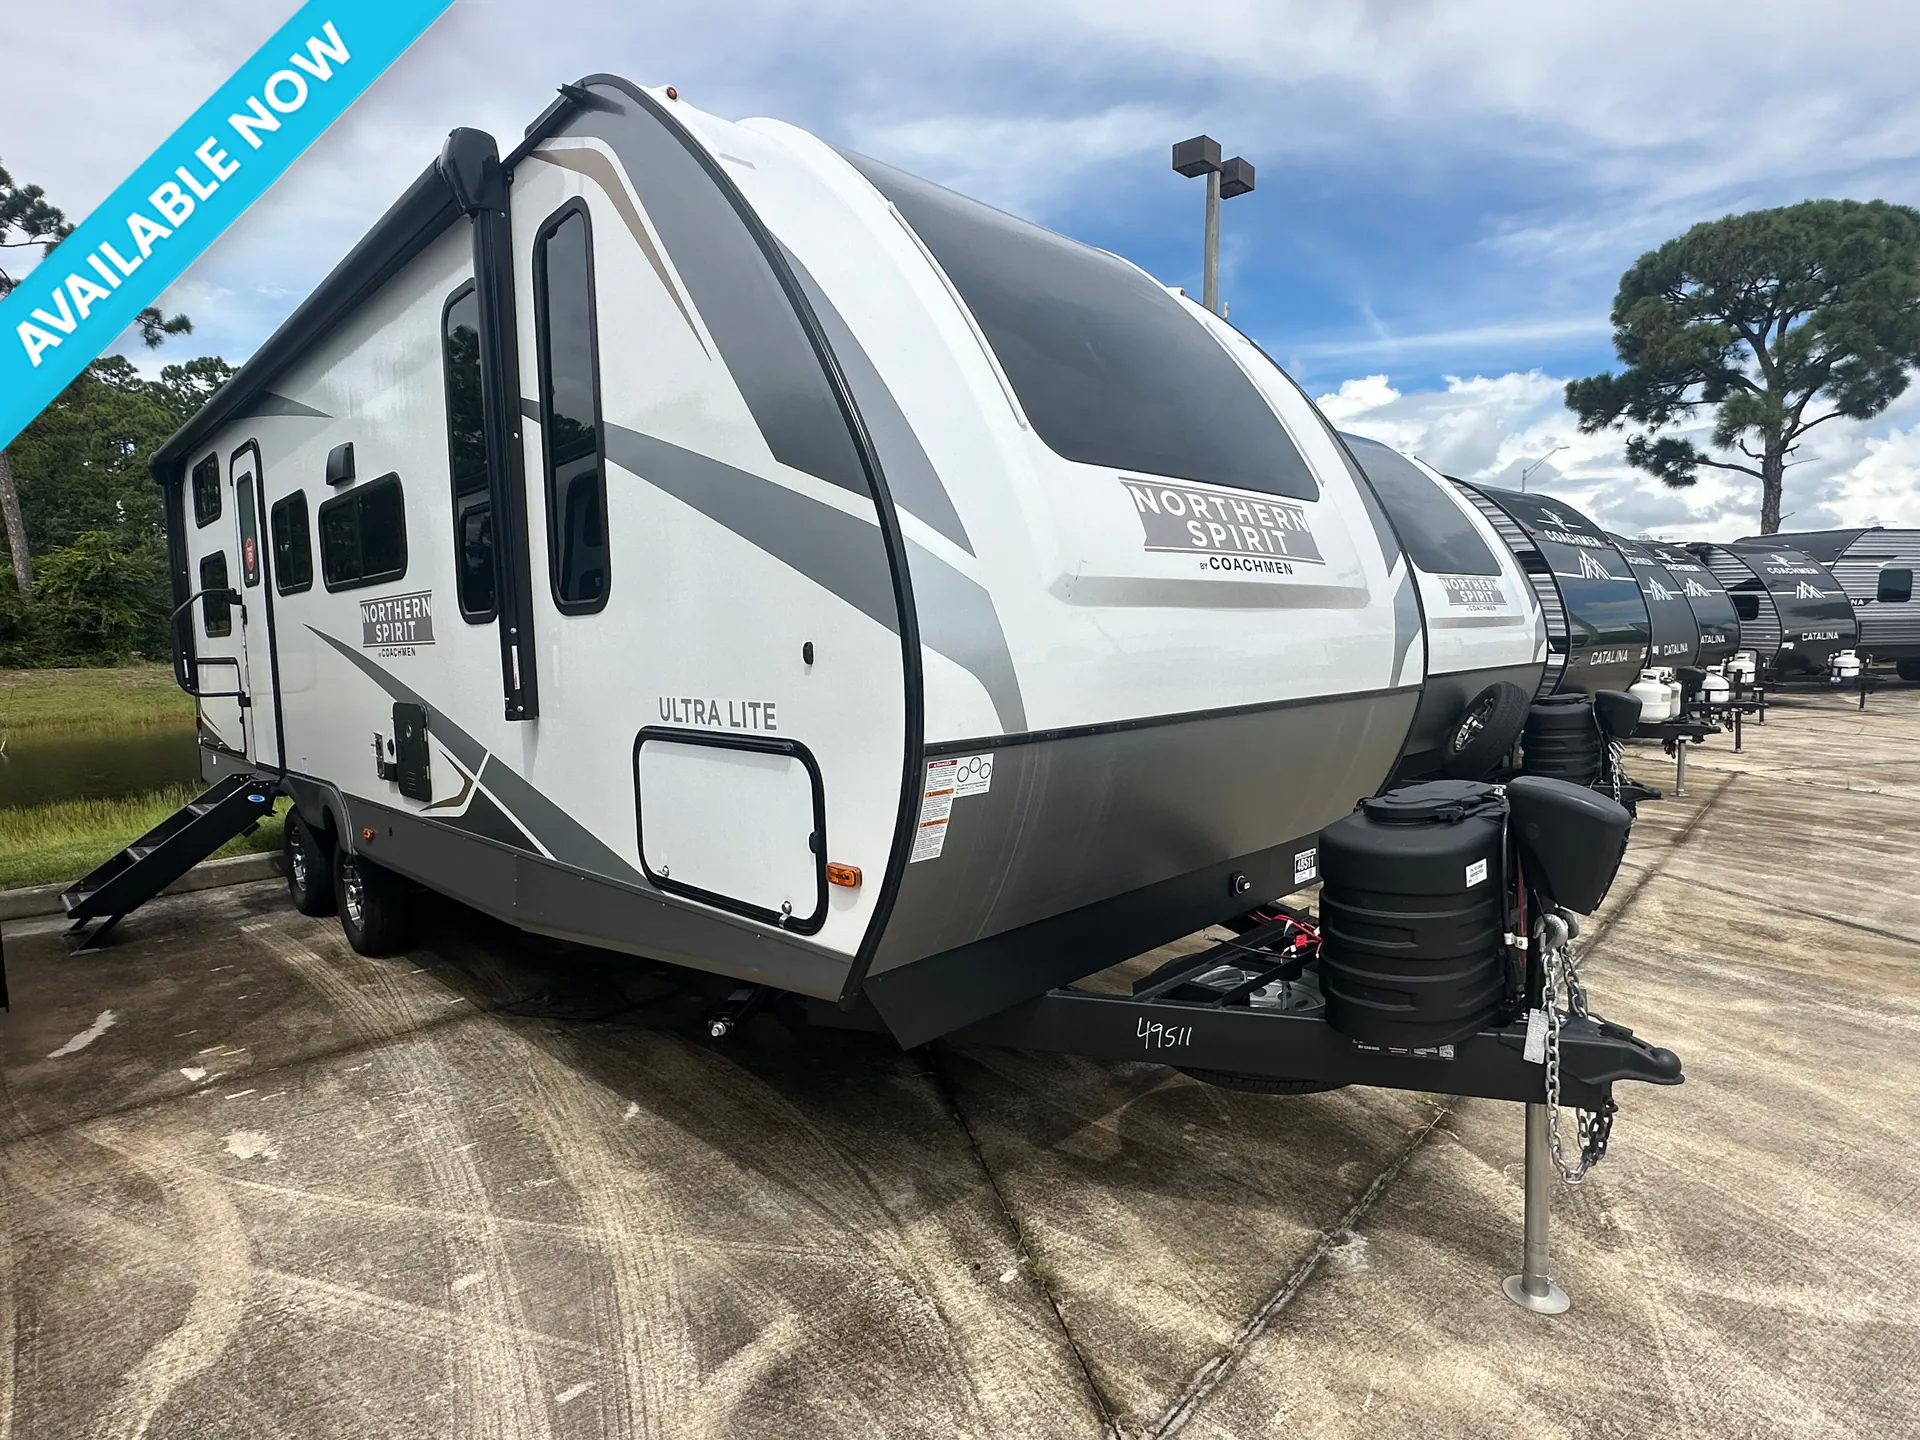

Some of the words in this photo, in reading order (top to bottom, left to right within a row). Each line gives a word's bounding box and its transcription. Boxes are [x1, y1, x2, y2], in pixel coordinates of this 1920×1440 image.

[1128, 485, 1310, 532] NORTHERN
[1186, 519, 1288, 554] SPIRIT
[1544, 530, 1602, 547] COACHMEN
[1200, 562, 1208, 570] BY
[1209, 557, 1293, 575] COACHMEN
[1440, 578, 1501, 591] NORTHERN
[1460, 591, 1495, 602] SPIRIT
[362, 596, 431, 623] NORTHERN
[376, 621, 415, 642] SPIRIT
[1700, 634, 1726, 645] ATALINA
[1802, 632, 1839, 641] CATALINA
[381, 647, 416, 657] COACHMEN
[1590, 650, 1629, 666] CATALINA
[1664, 643, 1689, 656] CATALINA
[659, 697, 722, 726] ULTRA
[728, 701, 777, 731] LITE
[1136, 1017, 1192, 1050] 49511
